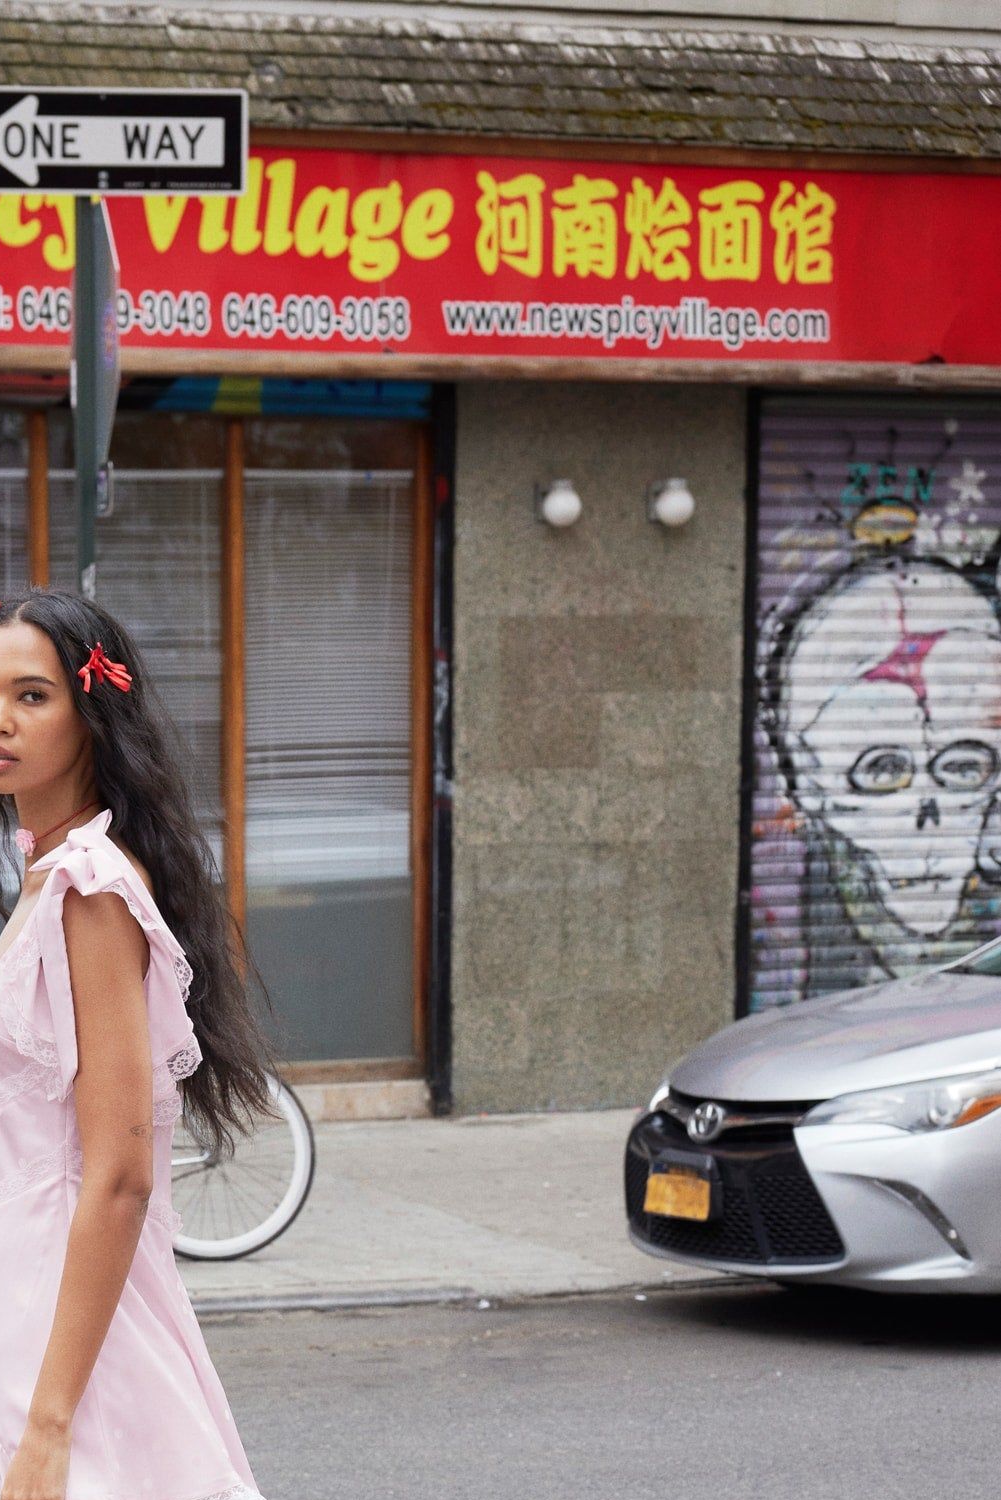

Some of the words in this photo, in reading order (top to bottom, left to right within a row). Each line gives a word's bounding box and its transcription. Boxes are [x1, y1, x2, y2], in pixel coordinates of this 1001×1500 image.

[3, 121, 81, 159] ONE
[122, 122, 206, 161] WAY
[142, 154, 454, 282] Village
[475, 170, 837, 284] 河南烩面馆
[20, 289, 209, 332] 6469-3048
[226, 296, 408, 338] 646-609-3058
[446, 298, 829, 346] www.newspicyvillage.com
